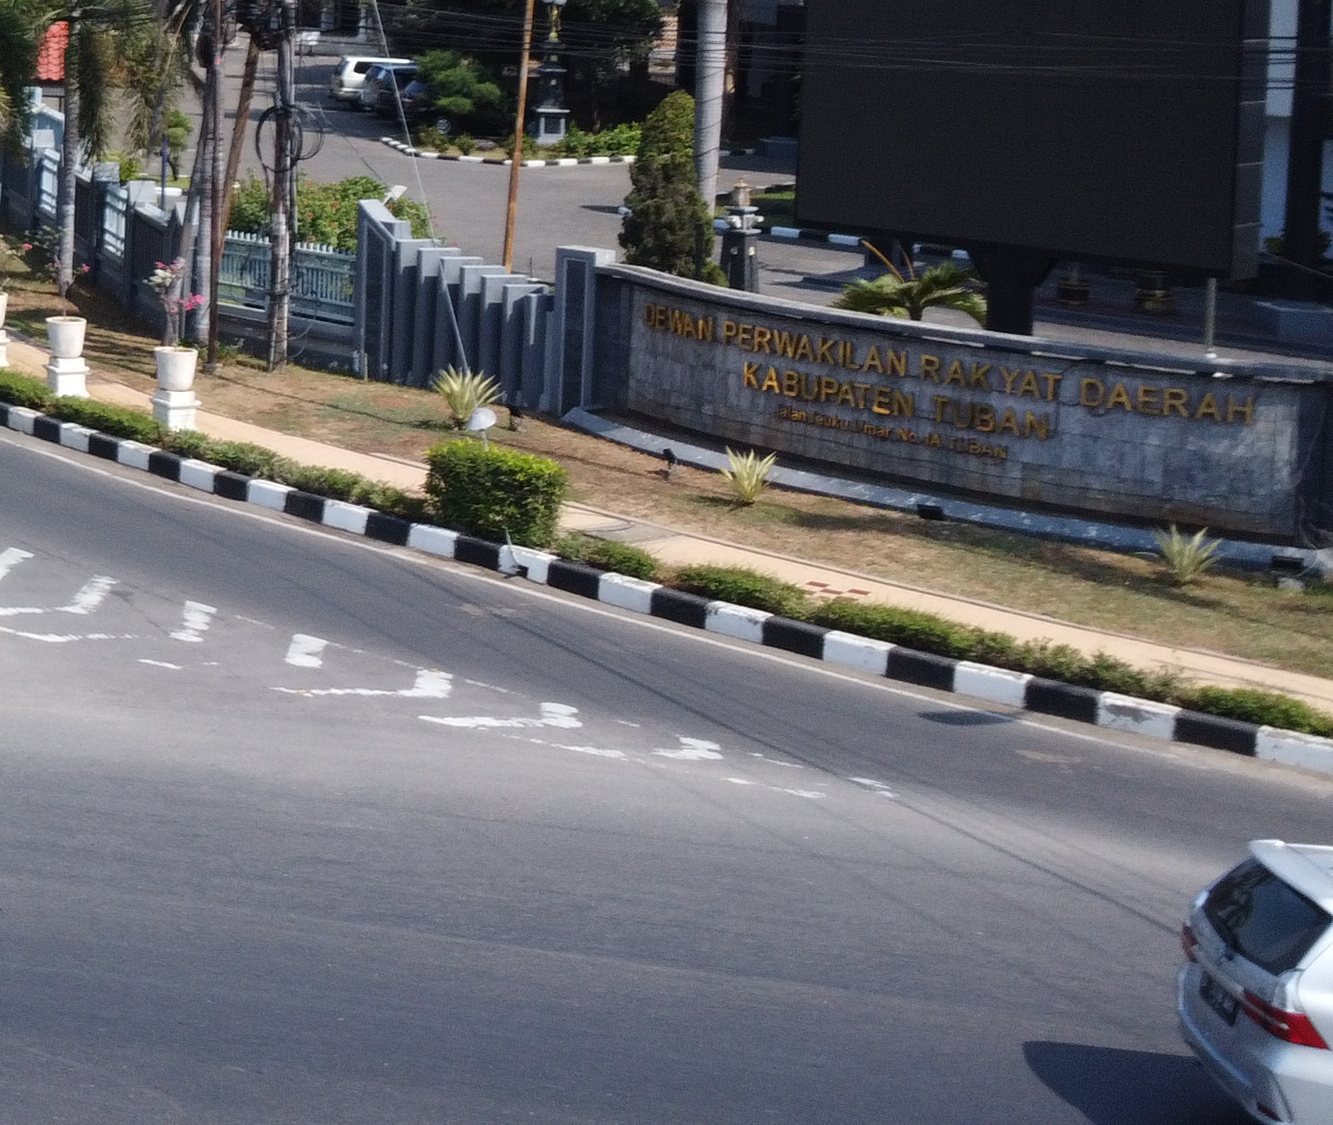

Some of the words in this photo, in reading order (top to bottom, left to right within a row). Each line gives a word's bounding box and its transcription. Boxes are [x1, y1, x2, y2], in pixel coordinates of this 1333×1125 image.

[643, 302, 715, 342] DEWAN
[722, 320, 908, 377] PERWAKILAN
[1080, 376, 1256, 426] DAERAH
[743, 362, 916, 418] KABUPATEN
[932, 395, 1051, 441] TUBAN
